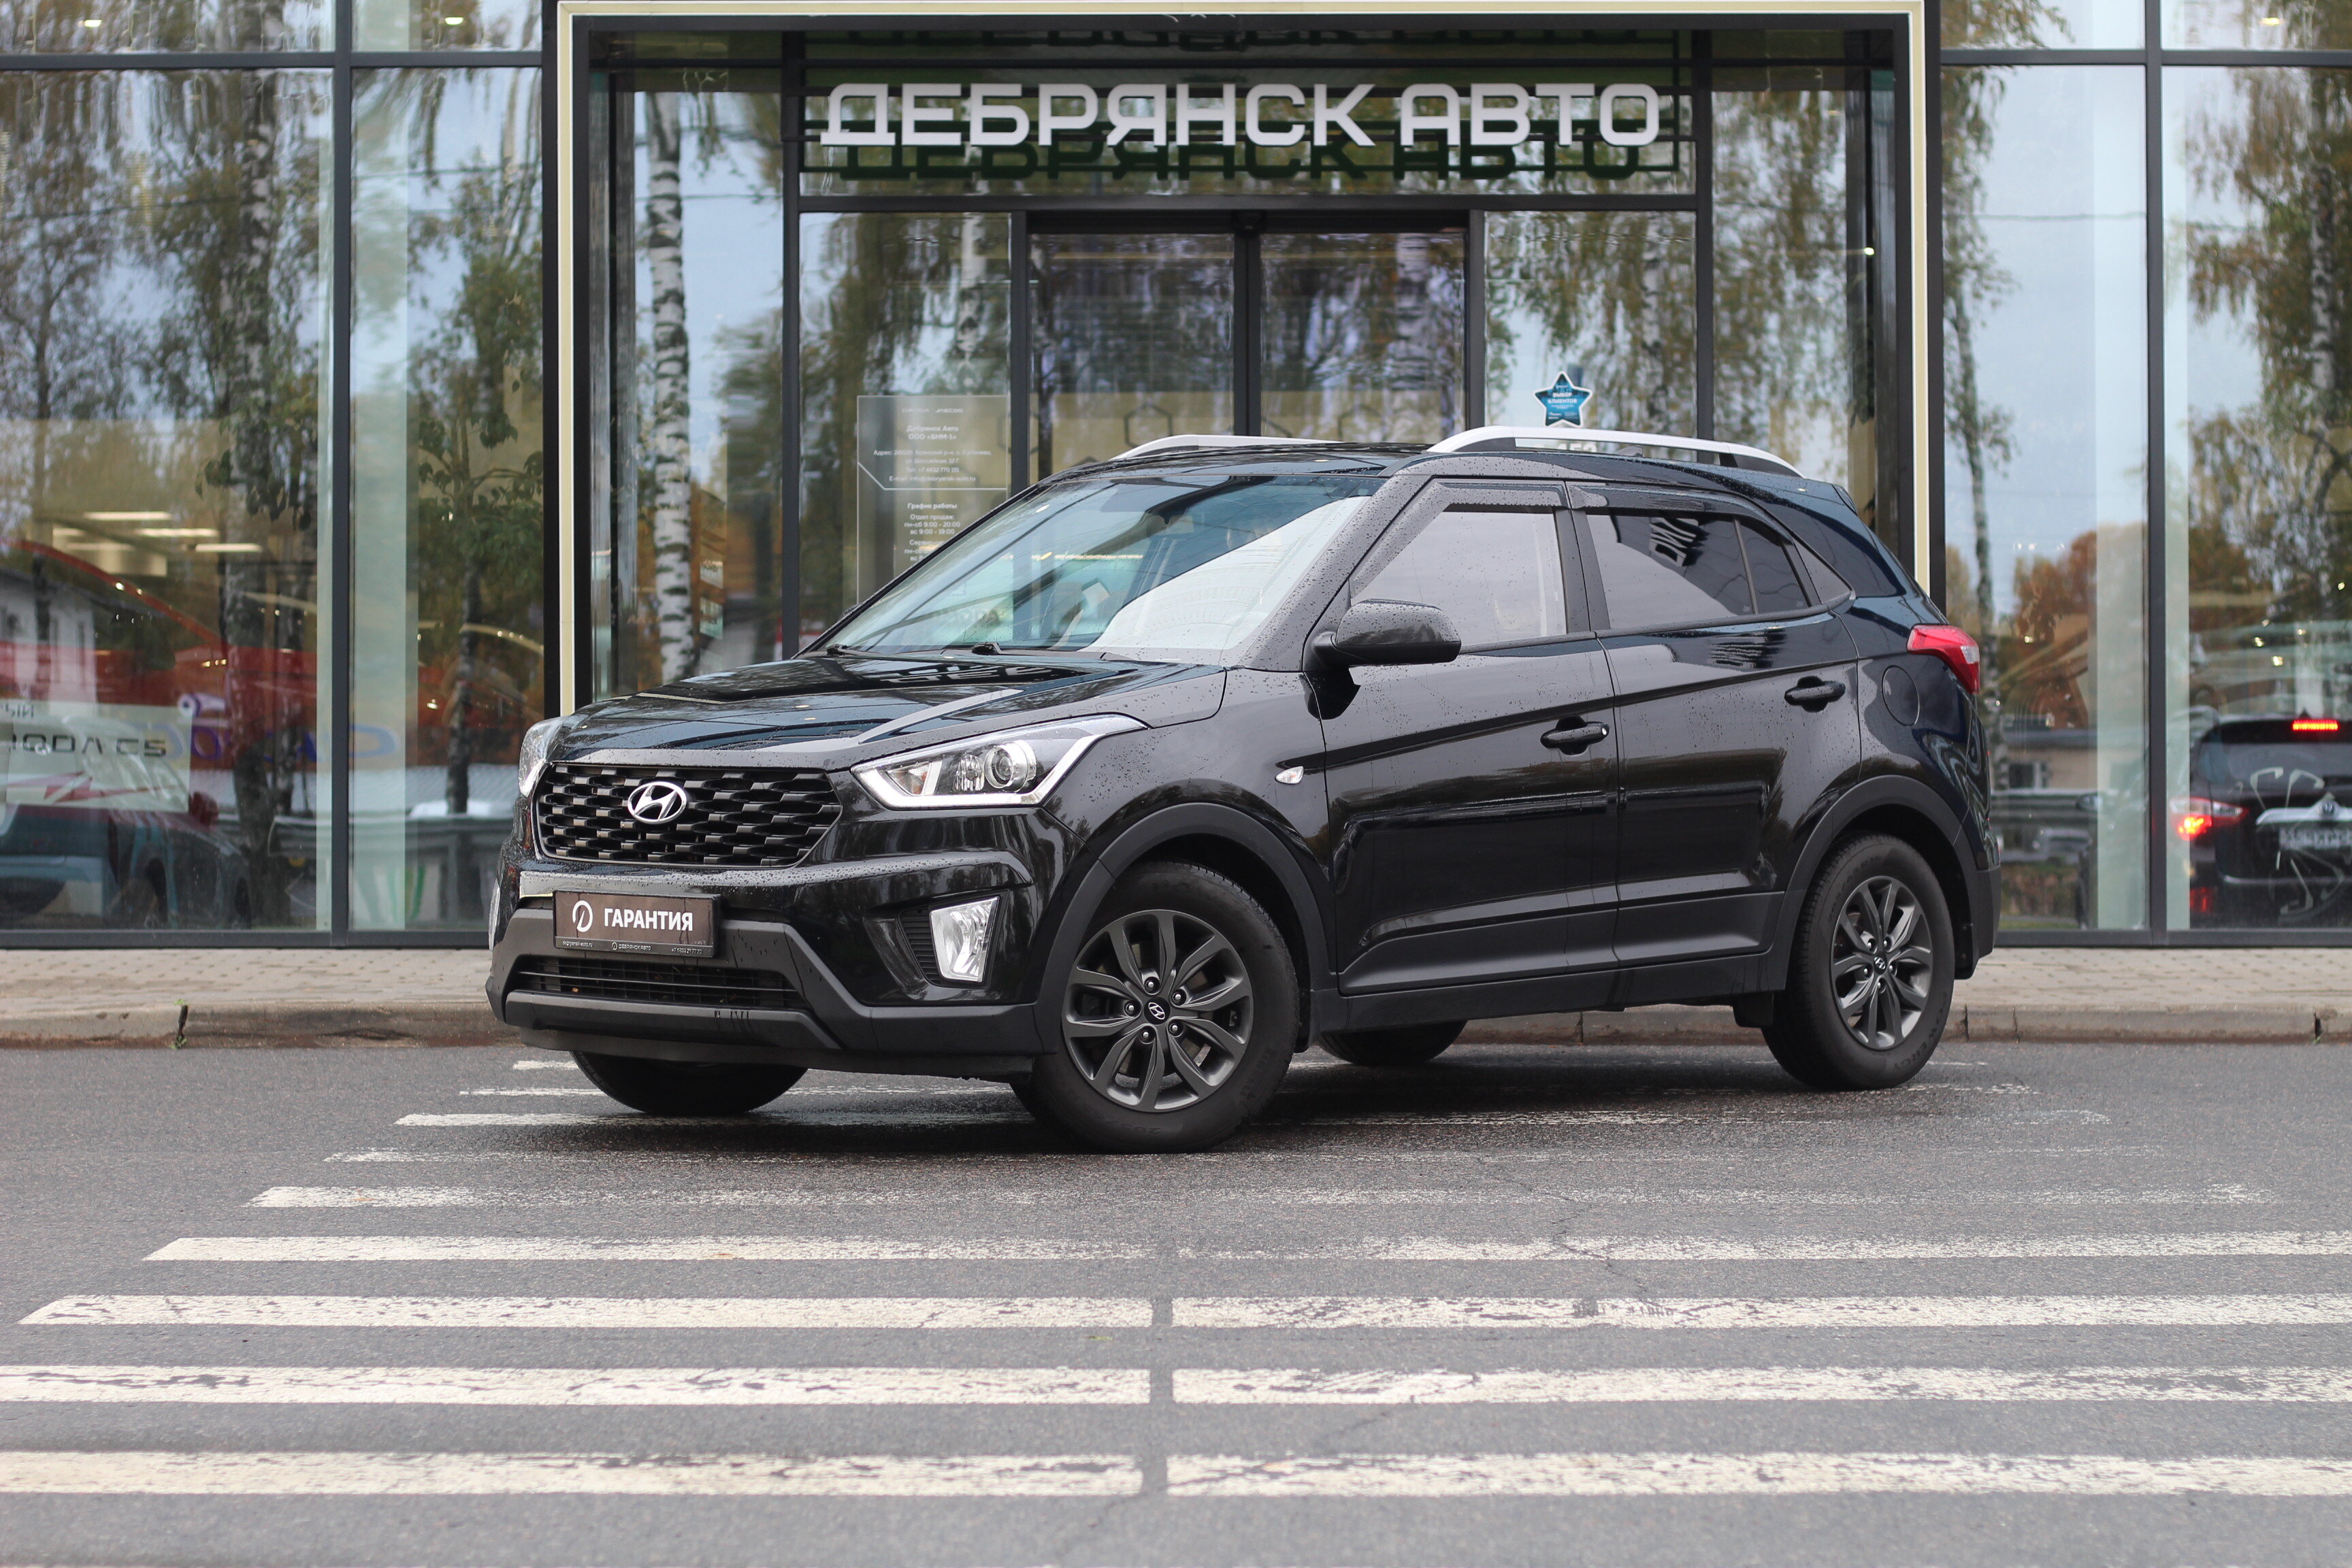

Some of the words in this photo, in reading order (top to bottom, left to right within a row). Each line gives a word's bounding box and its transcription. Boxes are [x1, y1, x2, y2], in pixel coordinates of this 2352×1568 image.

[820, 82, 1375, 148] ДЕБРЯНСК
[1399, 82, 1661, 146] АВТО
[604, 908, 693, 931] ГАРАНТИЯ
